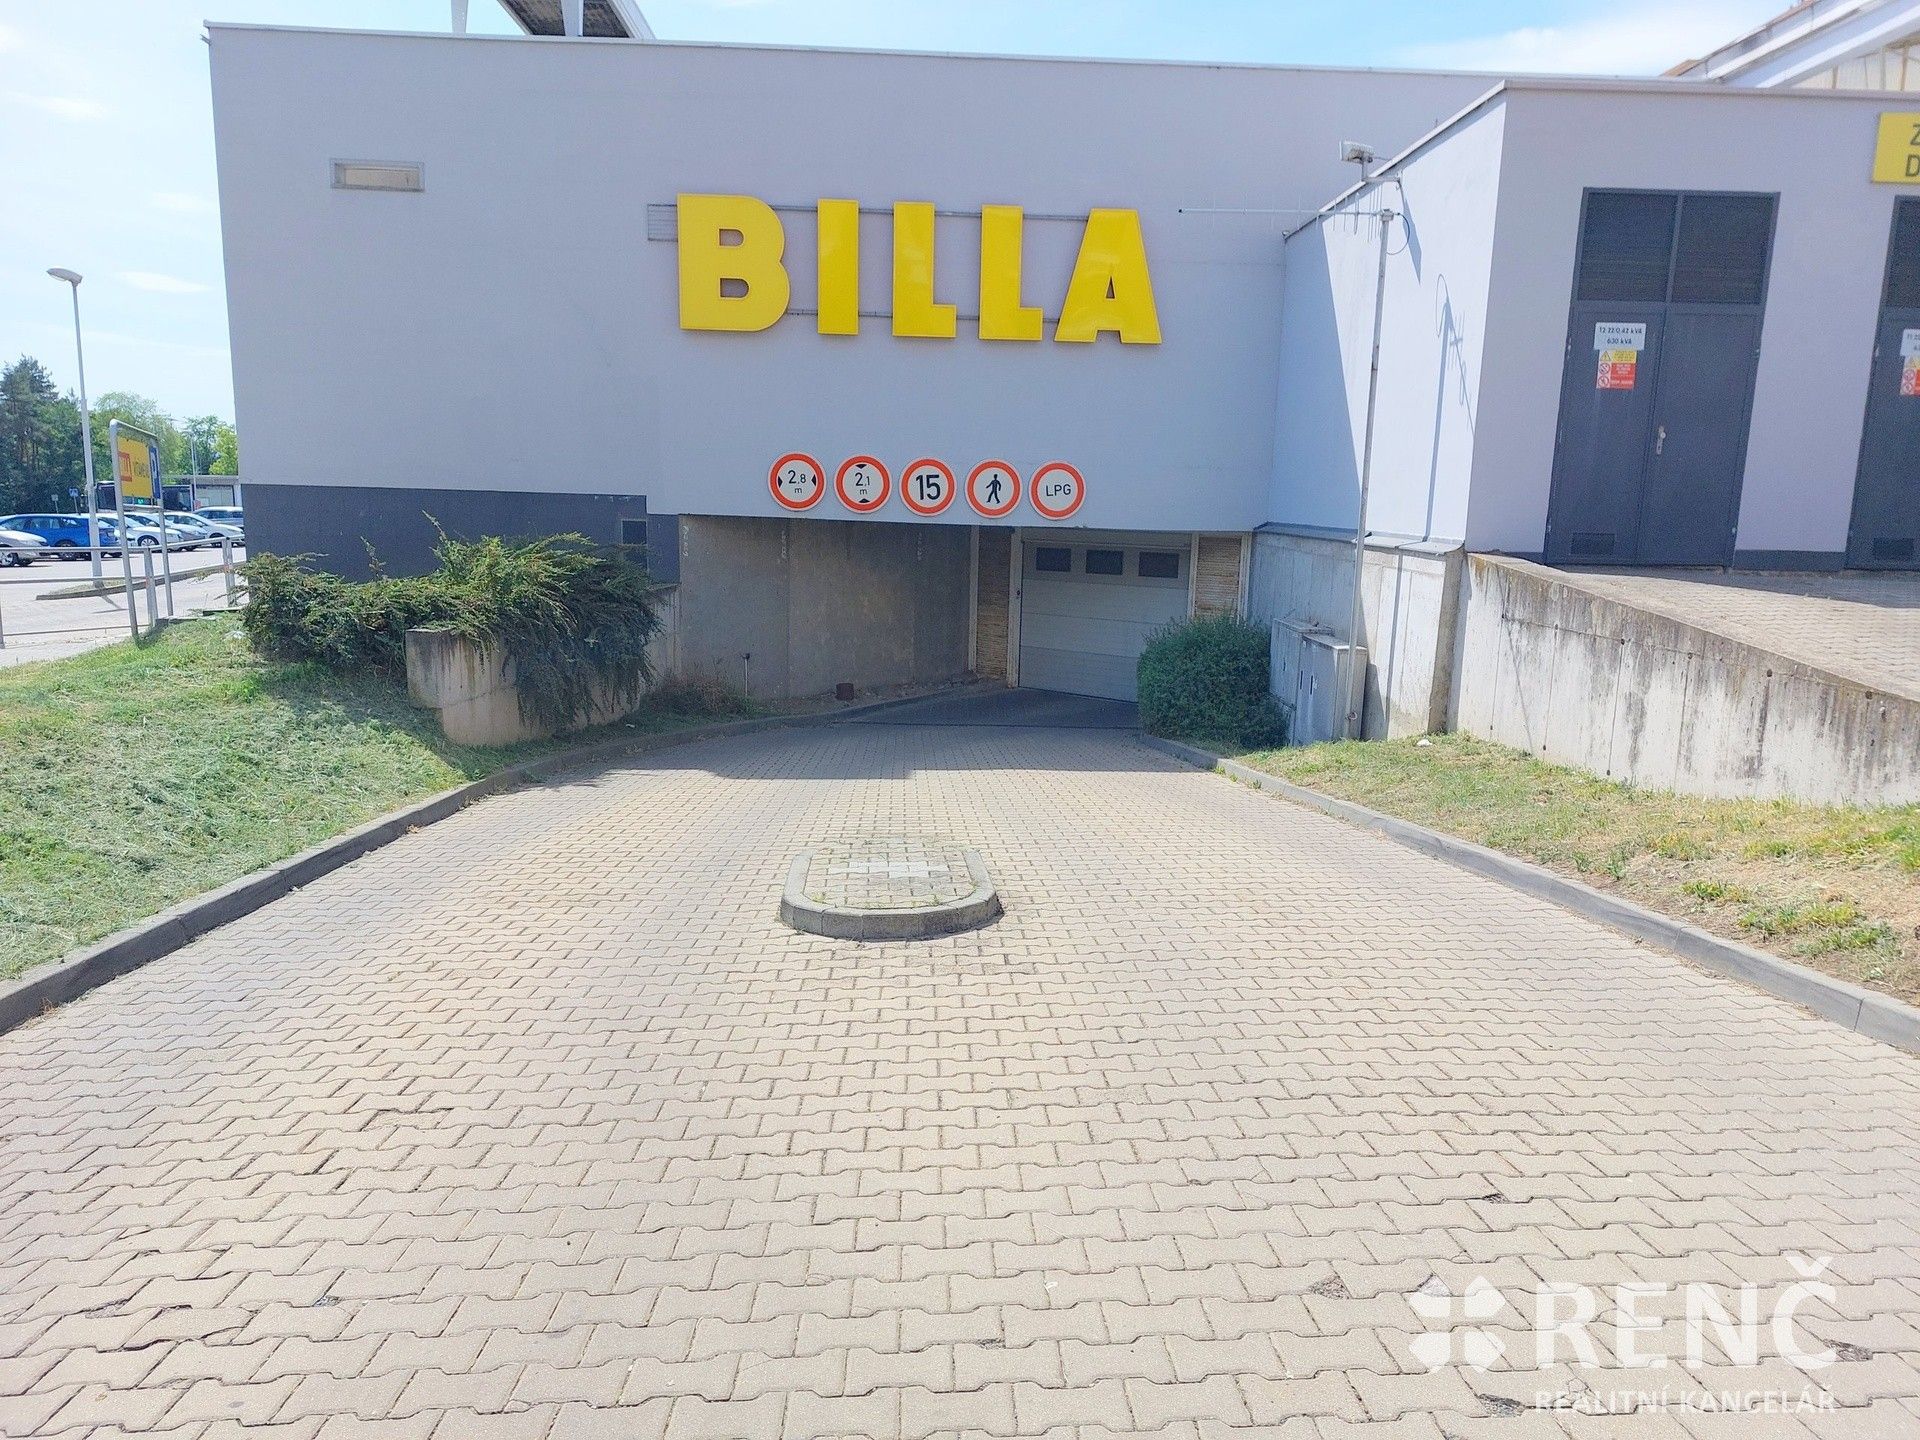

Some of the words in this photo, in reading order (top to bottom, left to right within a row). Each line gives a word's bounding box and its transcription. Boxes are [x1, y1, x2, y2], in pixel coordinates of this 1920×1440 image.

[677, 193, 1162, 345] BILLA
[794, 486, 803, 494] m
[916, 474, 941, 500] 15
[1045, 483, 1072, 497] LPG
